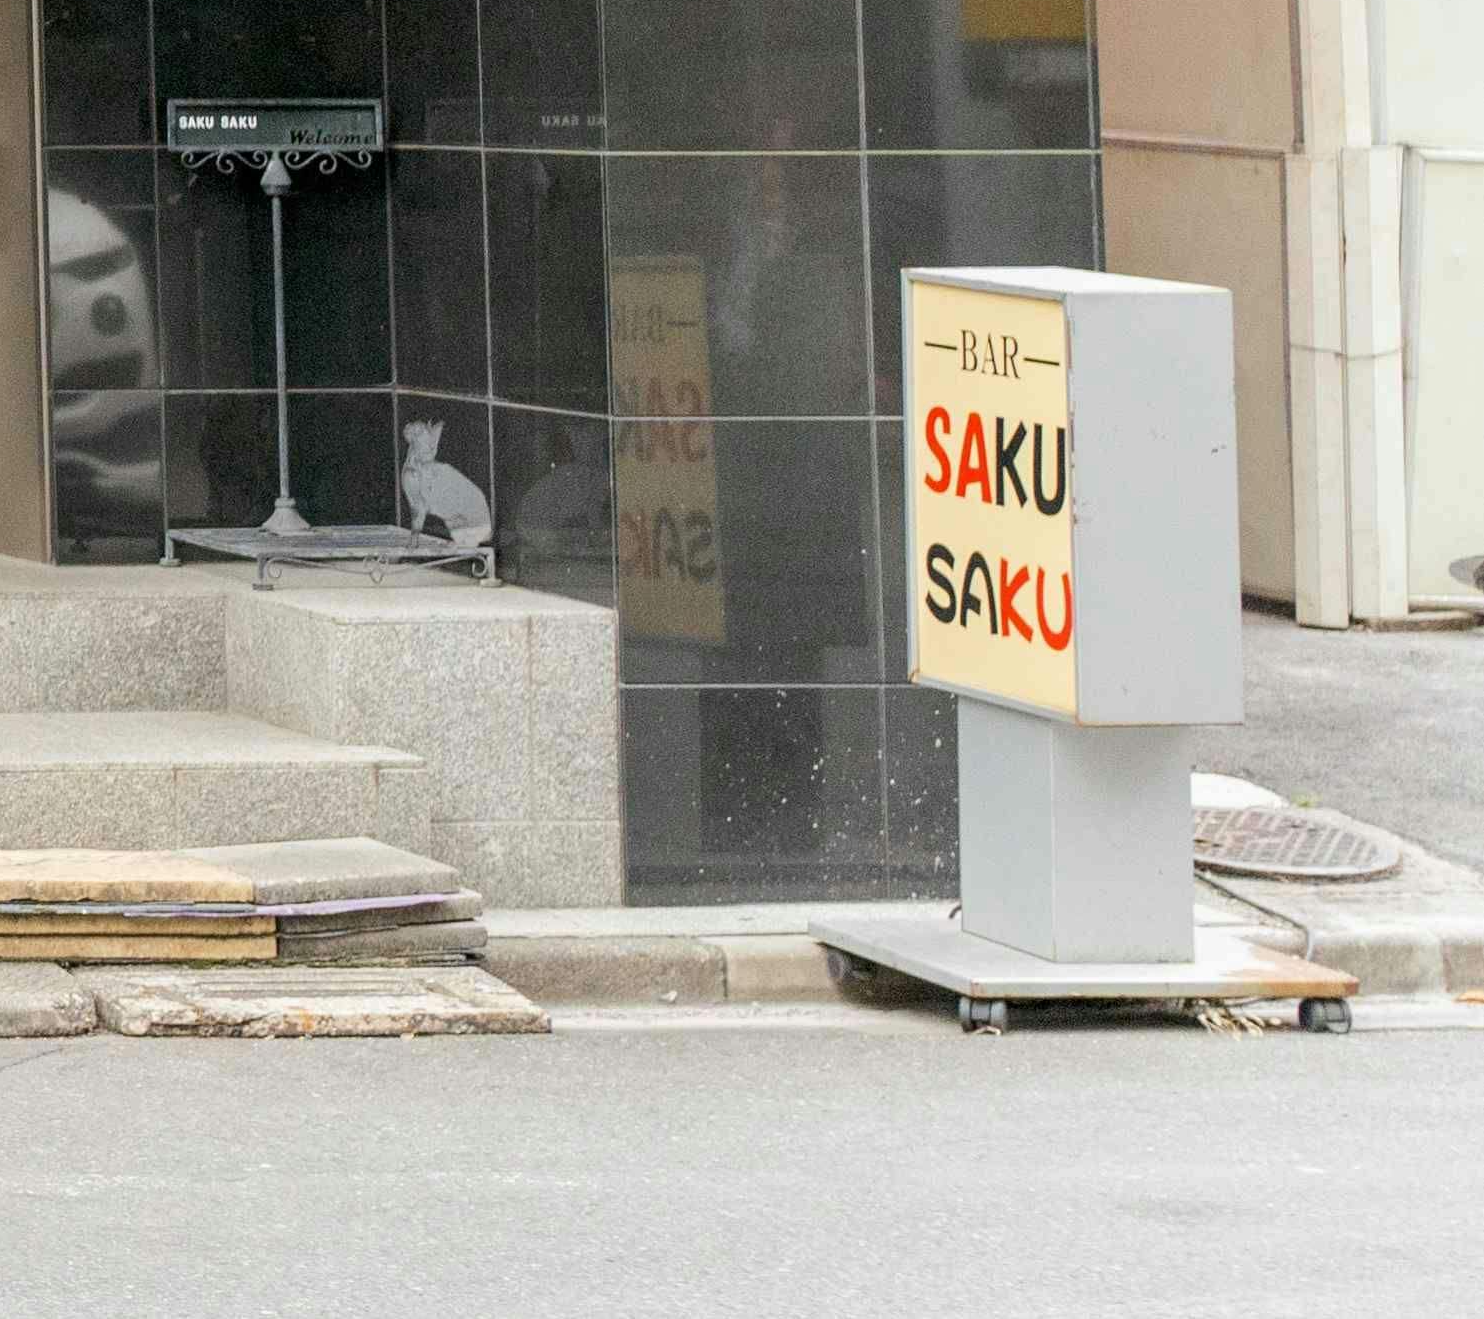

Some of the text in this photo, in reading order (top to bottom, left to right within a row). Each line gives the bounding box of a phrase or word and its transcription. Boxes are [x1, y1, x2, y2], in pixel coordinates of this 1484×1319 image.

[179, 115, 258, 129] SAKU SAKU
[289, 129, 376, 145] Welcome
[959, 329, 1021, 379] BAR
[924, 406, 1067, 516] SAKU
[925, 542, 1073, 651] SAKU
